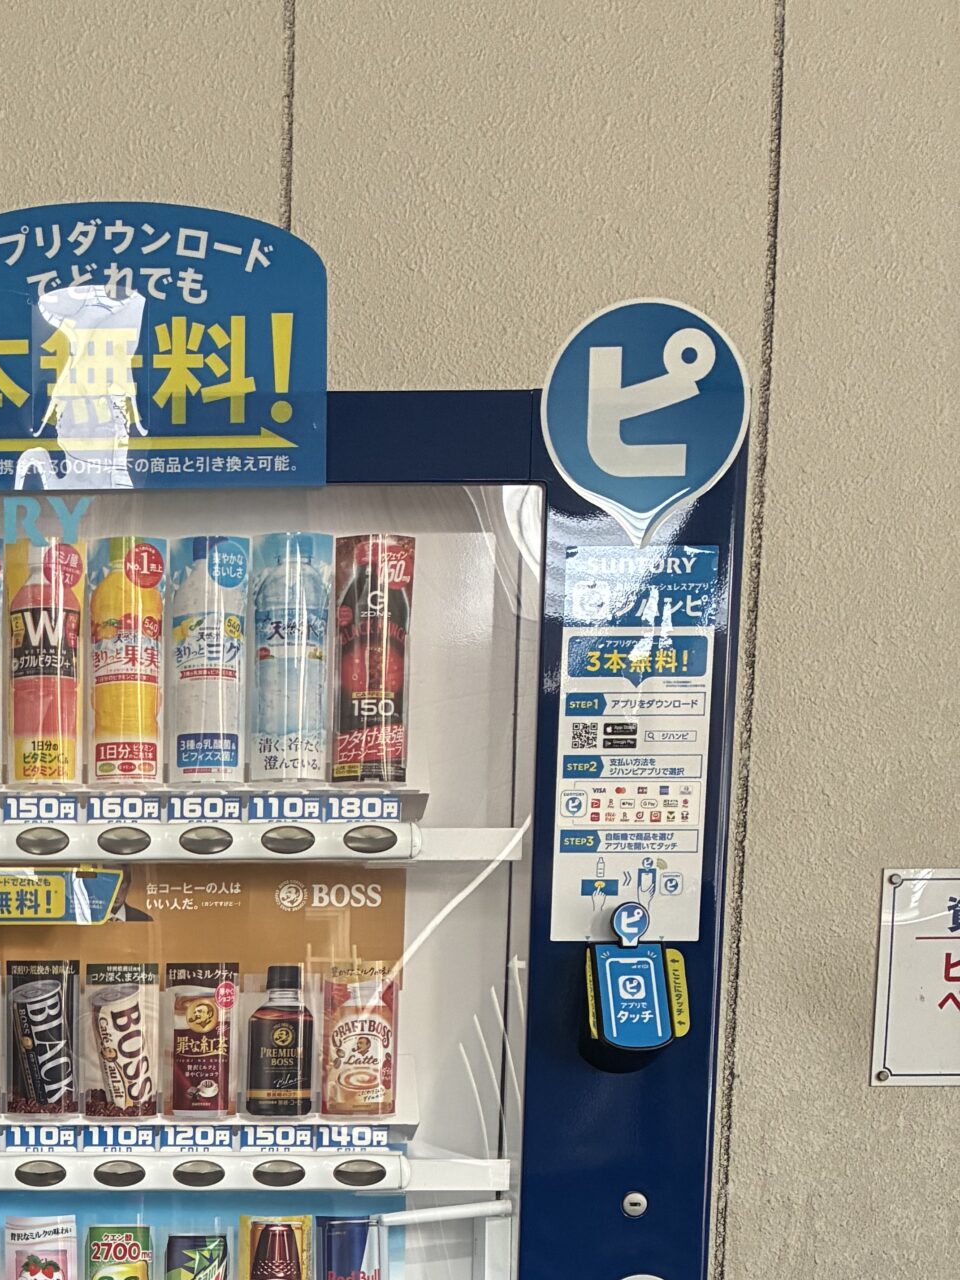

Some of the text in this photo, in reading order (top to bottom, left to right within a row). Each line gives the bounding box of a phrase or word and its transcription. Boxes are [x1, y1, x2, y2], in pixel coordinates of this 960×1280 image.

[26, 262, 210, 306] でどれでも
[587, 327, 717, 478] ピ
[586, 649, 690, 674] 3本無料!
[611, 697, 699, 710] アプリをダウンロード
[609, 757, 656, 767] 支払い方法を
[7, 797, 75, 818] 150円
[88, 797, 158, 818] 160円
[170, 797, 240, 818] 160円
[253, 797, 320, 818] 110円
[328, 797, 399, 818] 180円
[146, 882, 241, 896] 缶コーヒーの人は
[311, 882, 383, 908] BOSS
[145, 897, 199, 911] いい人だ。
[621, 908, 644, 934] ピ
[168, 967, 238, 982] 甘濃いミルクティー
[672, 969, 684, 1017] ここにタッチ
[620, 1001, 648, 1010] アプリで
[617, 1010, 654, 1024] タッチ
[25, 991, 76, 1104] BLACK
[110, 1000, 153, 1102] BOSS
[271, 1057, 294, 1066] BOSS
[9, 1126, 74, 1146] 110円
[87, 1126, 153, 1146] 110円
[166, 1126, 230, 1146] 120円
[244, 1126, 311, 1146] 150円
[316, 1126, 388, 1146] 140円
